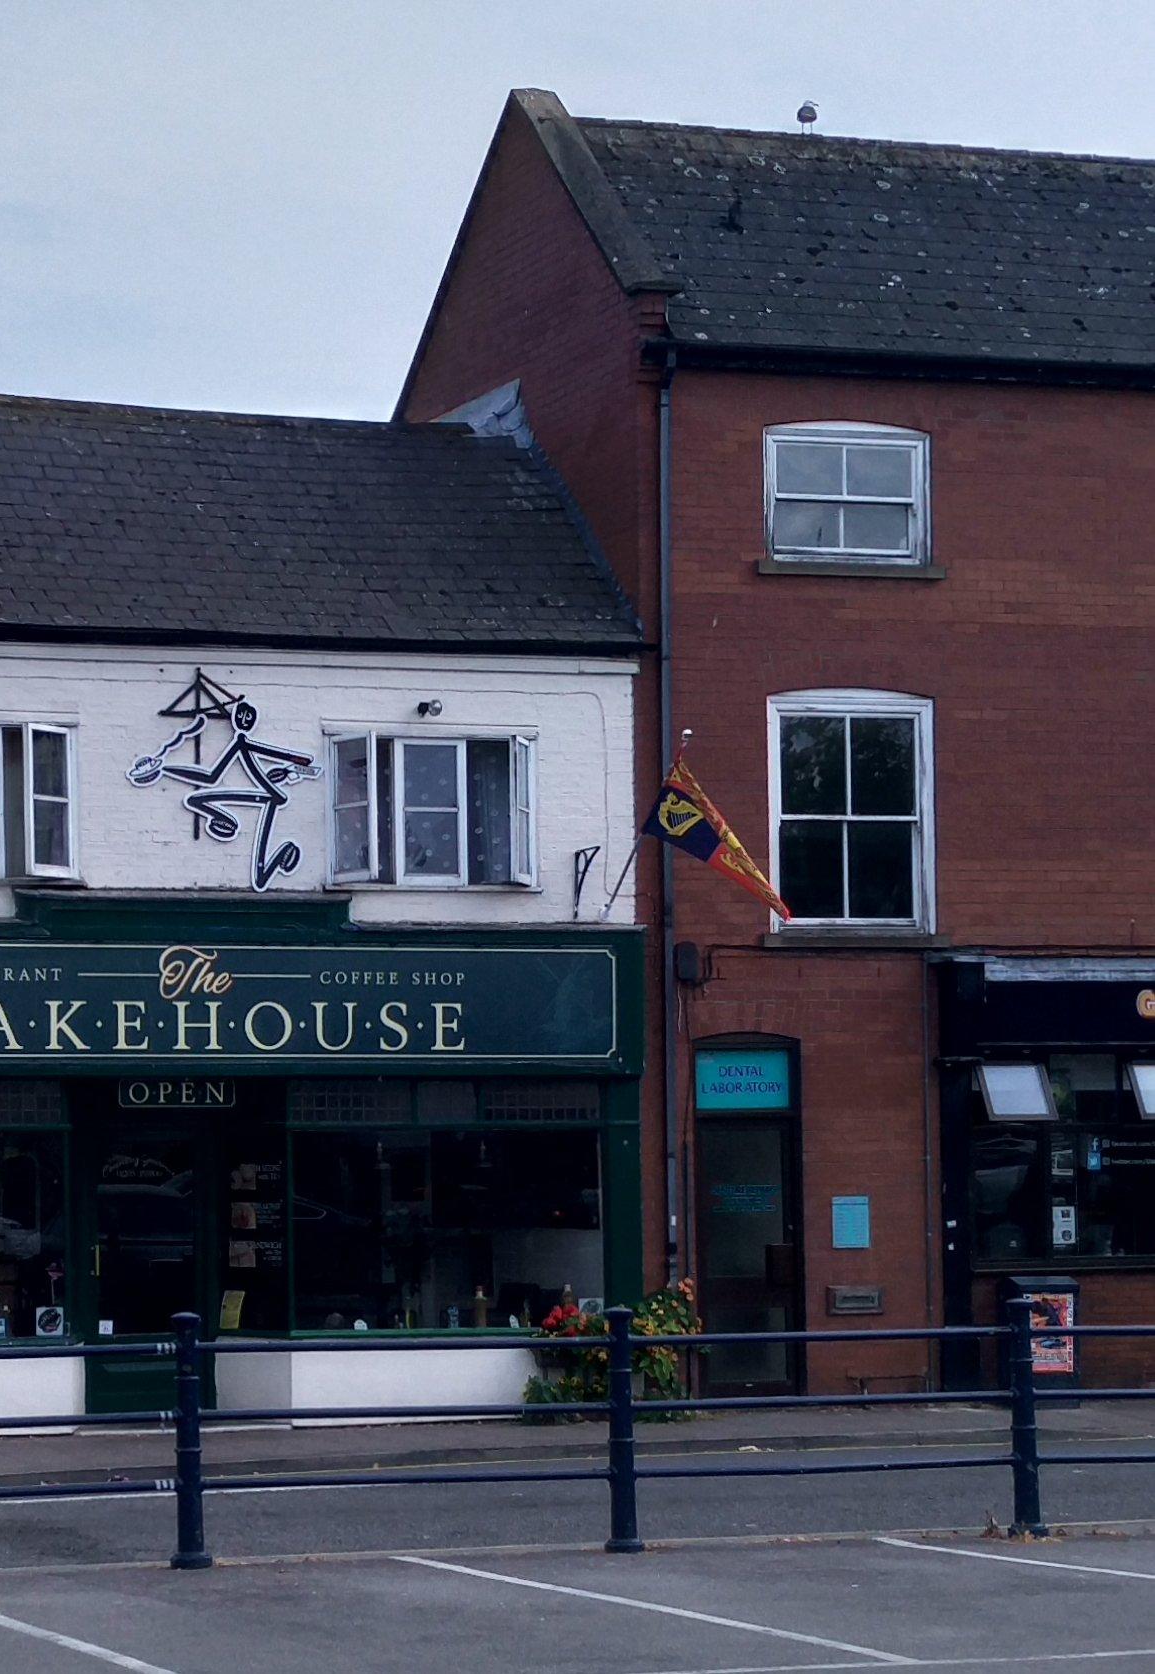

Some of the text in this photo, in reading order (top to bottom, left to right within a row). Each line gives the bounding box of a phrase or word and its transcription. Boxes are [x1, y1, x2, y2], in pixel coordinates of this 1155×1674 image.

[159, 945, 233, 999] The
[319, 971, 466, 986] COFFEE SHOP
[718, 1065, 764, 1078] DENTAL
[701, 1081, 782, 1095] LABORATORY
